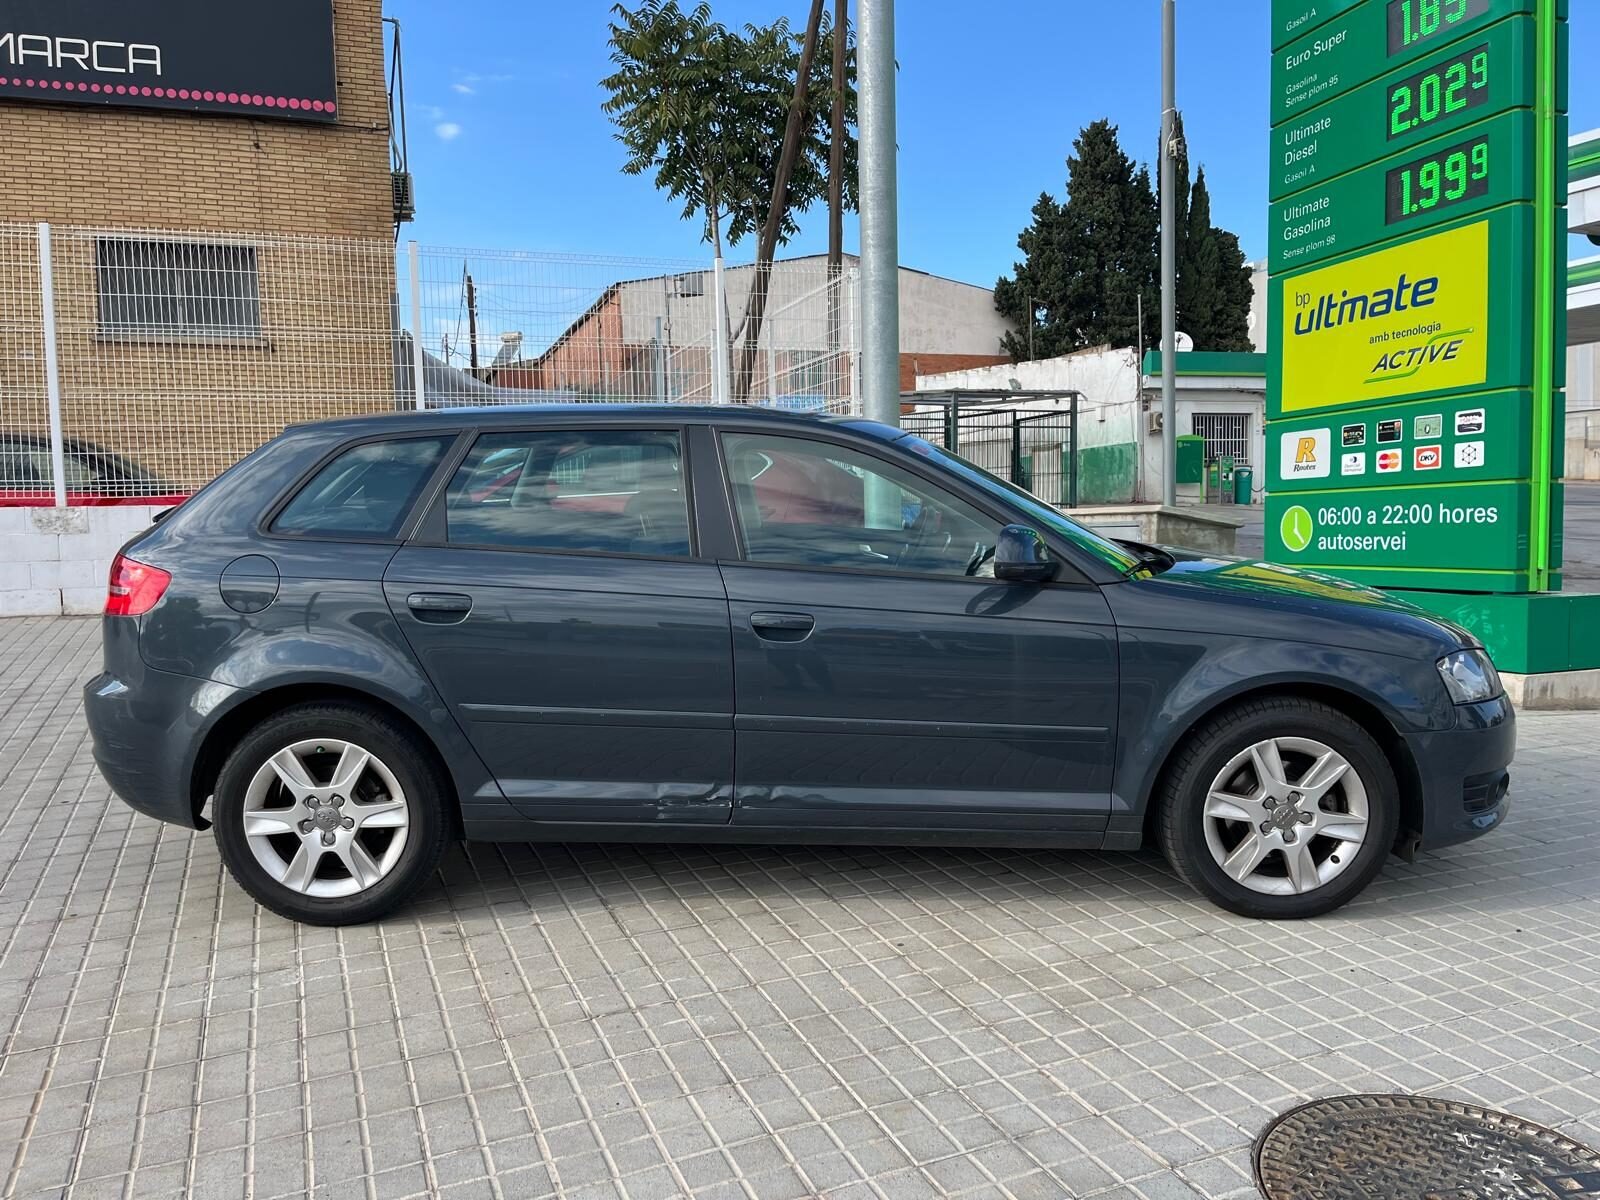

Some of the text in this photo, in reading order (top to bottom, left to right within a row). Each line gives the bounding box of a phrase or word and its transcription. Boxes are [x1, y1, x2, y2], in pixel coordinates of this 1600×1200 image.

[1286, 8, 1317, 31] Gasoil A
[1286, 30, 1347, 70] Euro Super
[1285, 74, 1338, 108] Sense plom 95
[1286, 74, 1318, 95] Gasolina
[1285, 117, 1331, 146] Ultimate
[1284, 139, 1317, 166] Diesel
[1284, 164, 1315, 184] Gasoil A
[1283, 196, 1330, 222] Ultimate
[1283, 216, 1331, 241] Gasolina
[1283, 234, 1336, 260] Sense plom 98
[1294, 273, 1439, 336] ultimate
[1295, 291, 1310, 308] bp
[1369, 320, 1441, 344] amb tecnologia
[1371, 339, 1463, 373] ACTIVE
[1420, 453, 1436, 463] DKV
[1318, 503, 1498, 525] 06:00 a 22:00 hores
[1318, 531, 1406, 551] autoservei
